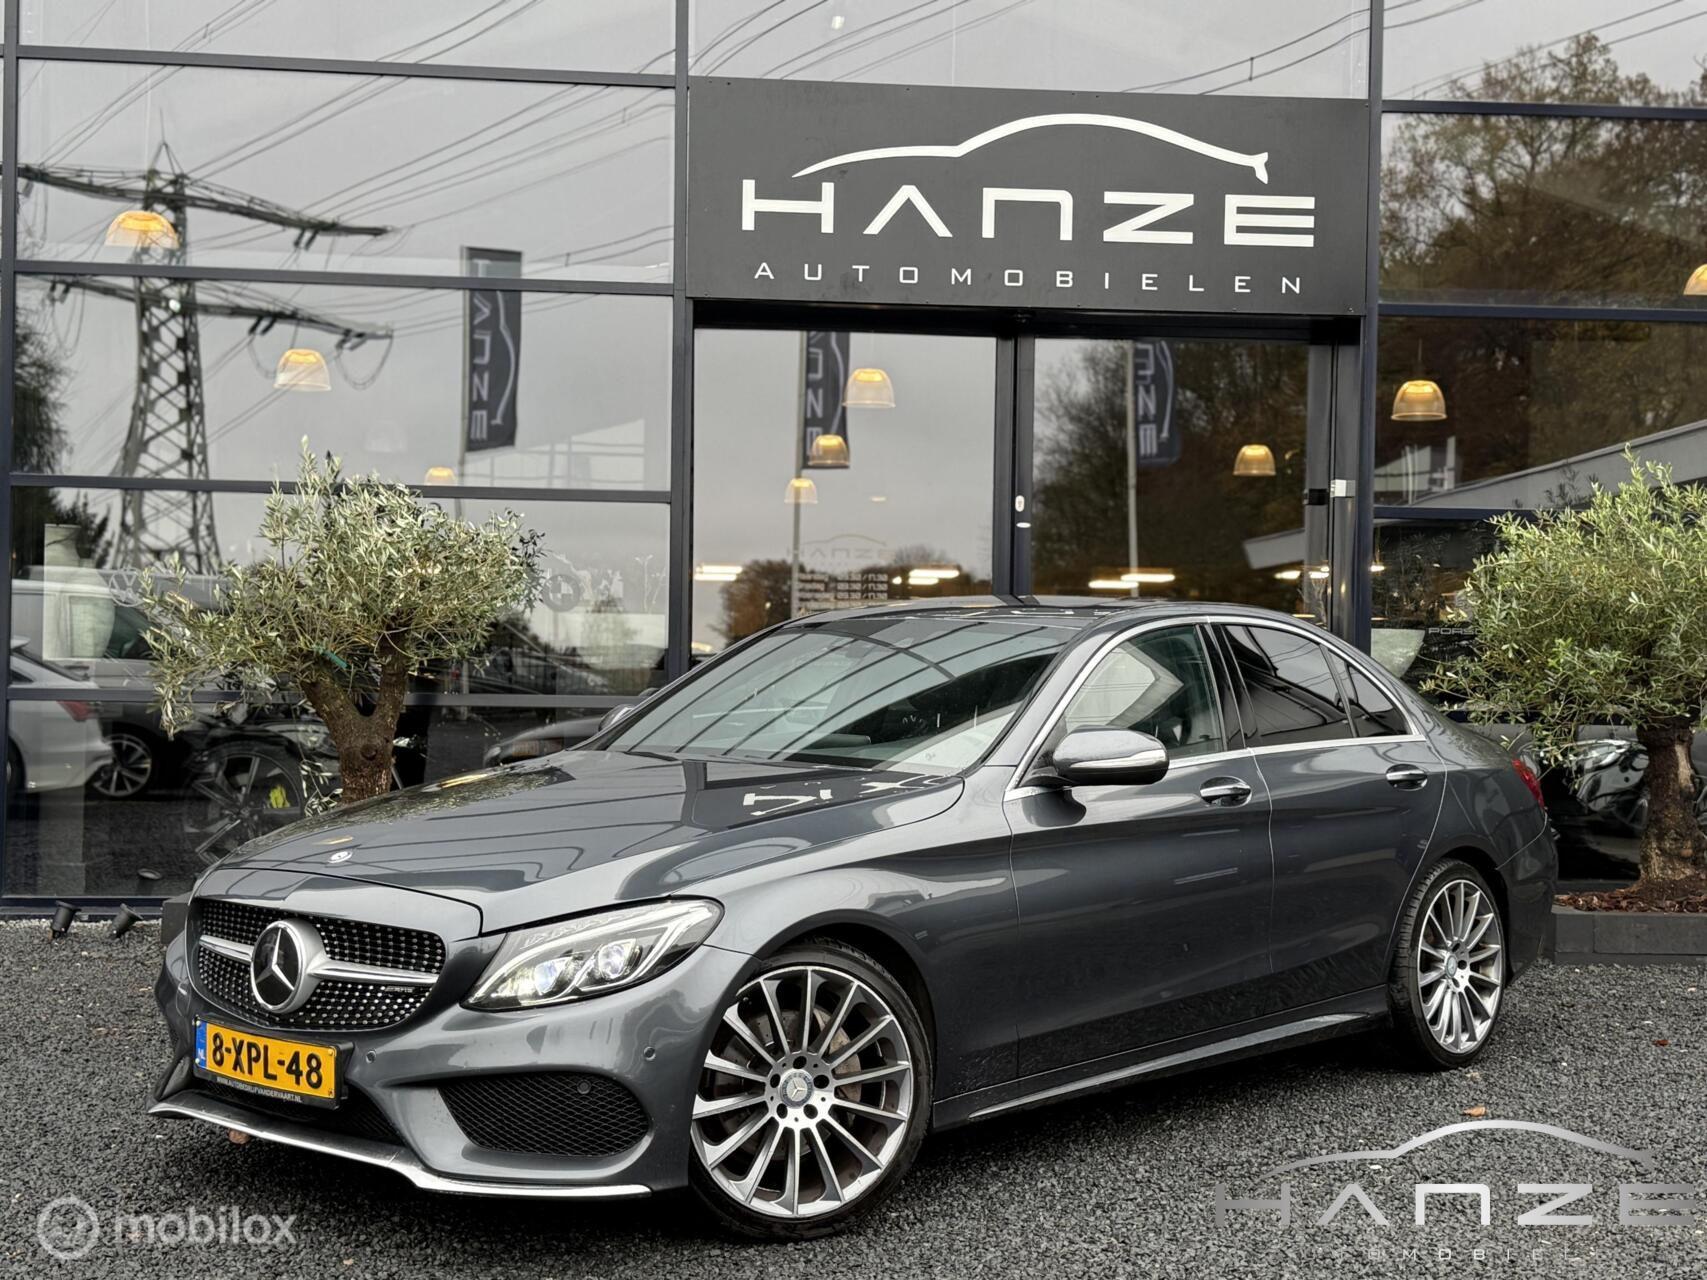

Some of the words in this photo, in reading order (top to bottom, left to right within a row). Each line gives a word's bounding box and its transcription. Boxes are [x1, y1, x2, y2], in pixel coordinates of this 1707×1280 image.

[741, 178, 1316, 248] HANZE
[754, 262, 1302, 295] AUTOMOBIELEN
[212, 1032, 323, 1089] 8-XPL-48
